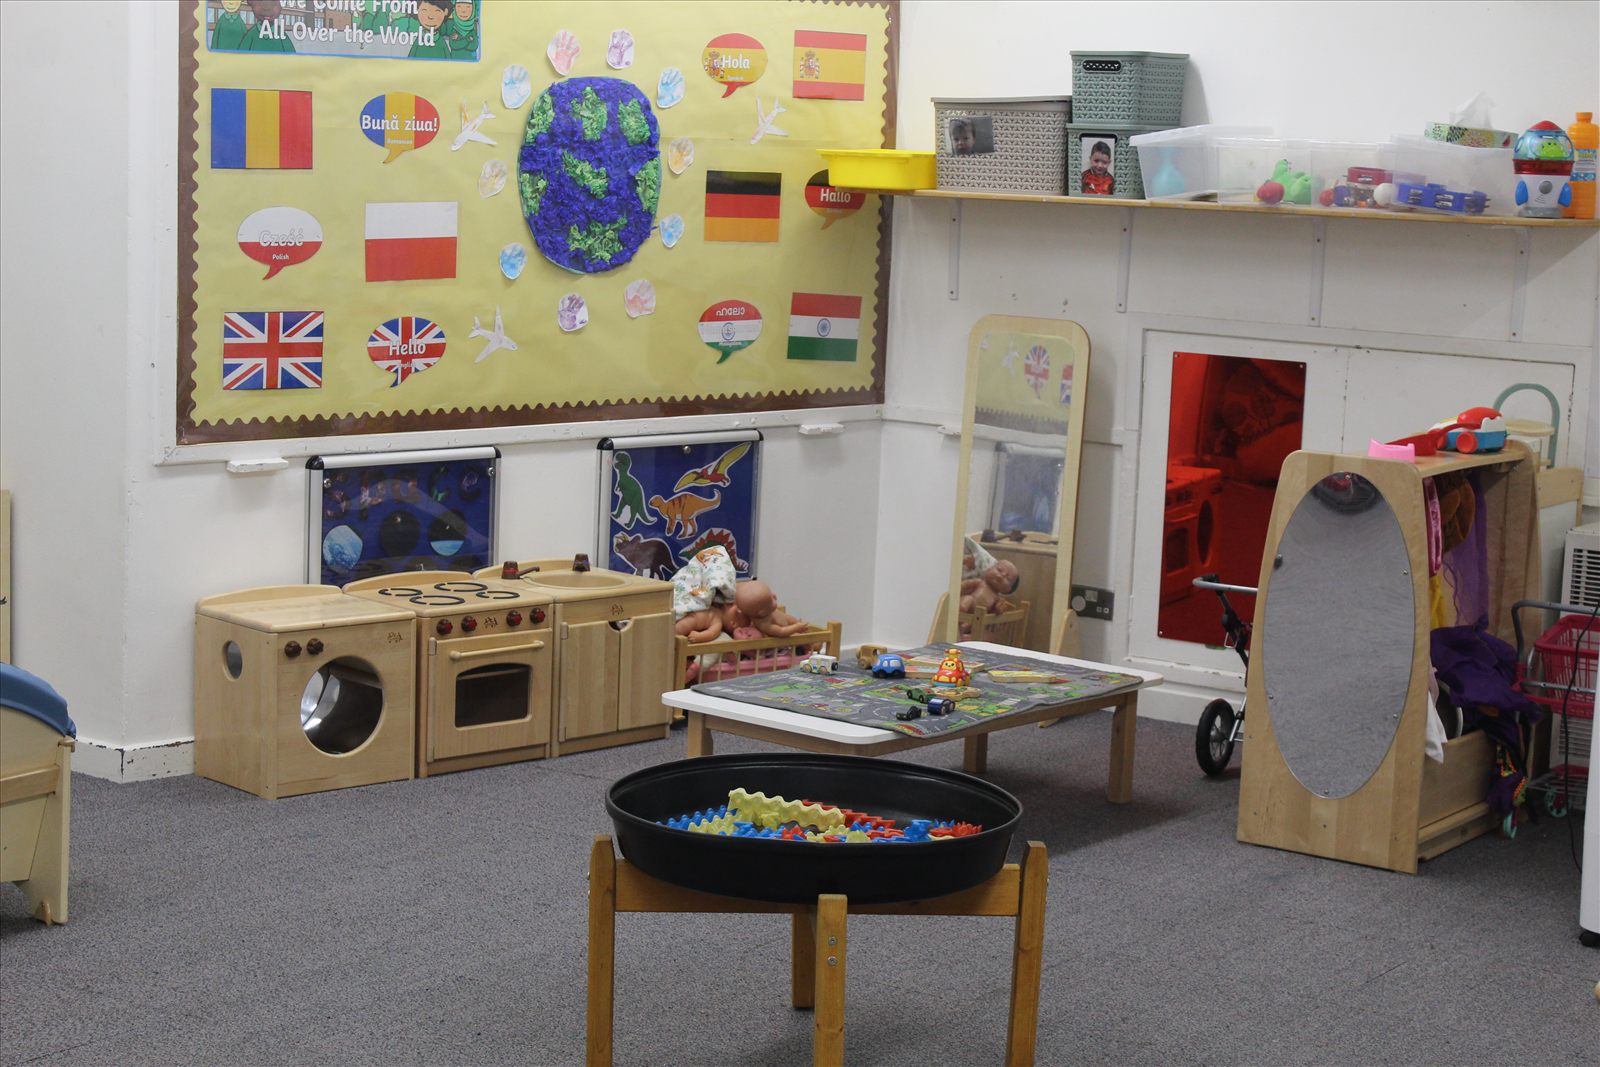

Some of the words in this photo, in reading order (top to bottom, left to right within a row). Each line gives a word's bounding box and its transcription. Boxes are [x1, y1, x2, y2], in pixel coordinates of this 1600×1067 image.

[259, 18, 286, 40] All
[293, 22, 337, 42] Over
[344, 23, 374, 44] the
[380, 26, 435, 47] World
[721, 53, 751, 69] Hola
[361, 114, 399, 130] Bună
[404, 116, 438, 132] ziua!
[820, 188, 851, 203] Hallo
[259, 227, 304, 247] Cześć
[389, 338, 427, 356] Hello
